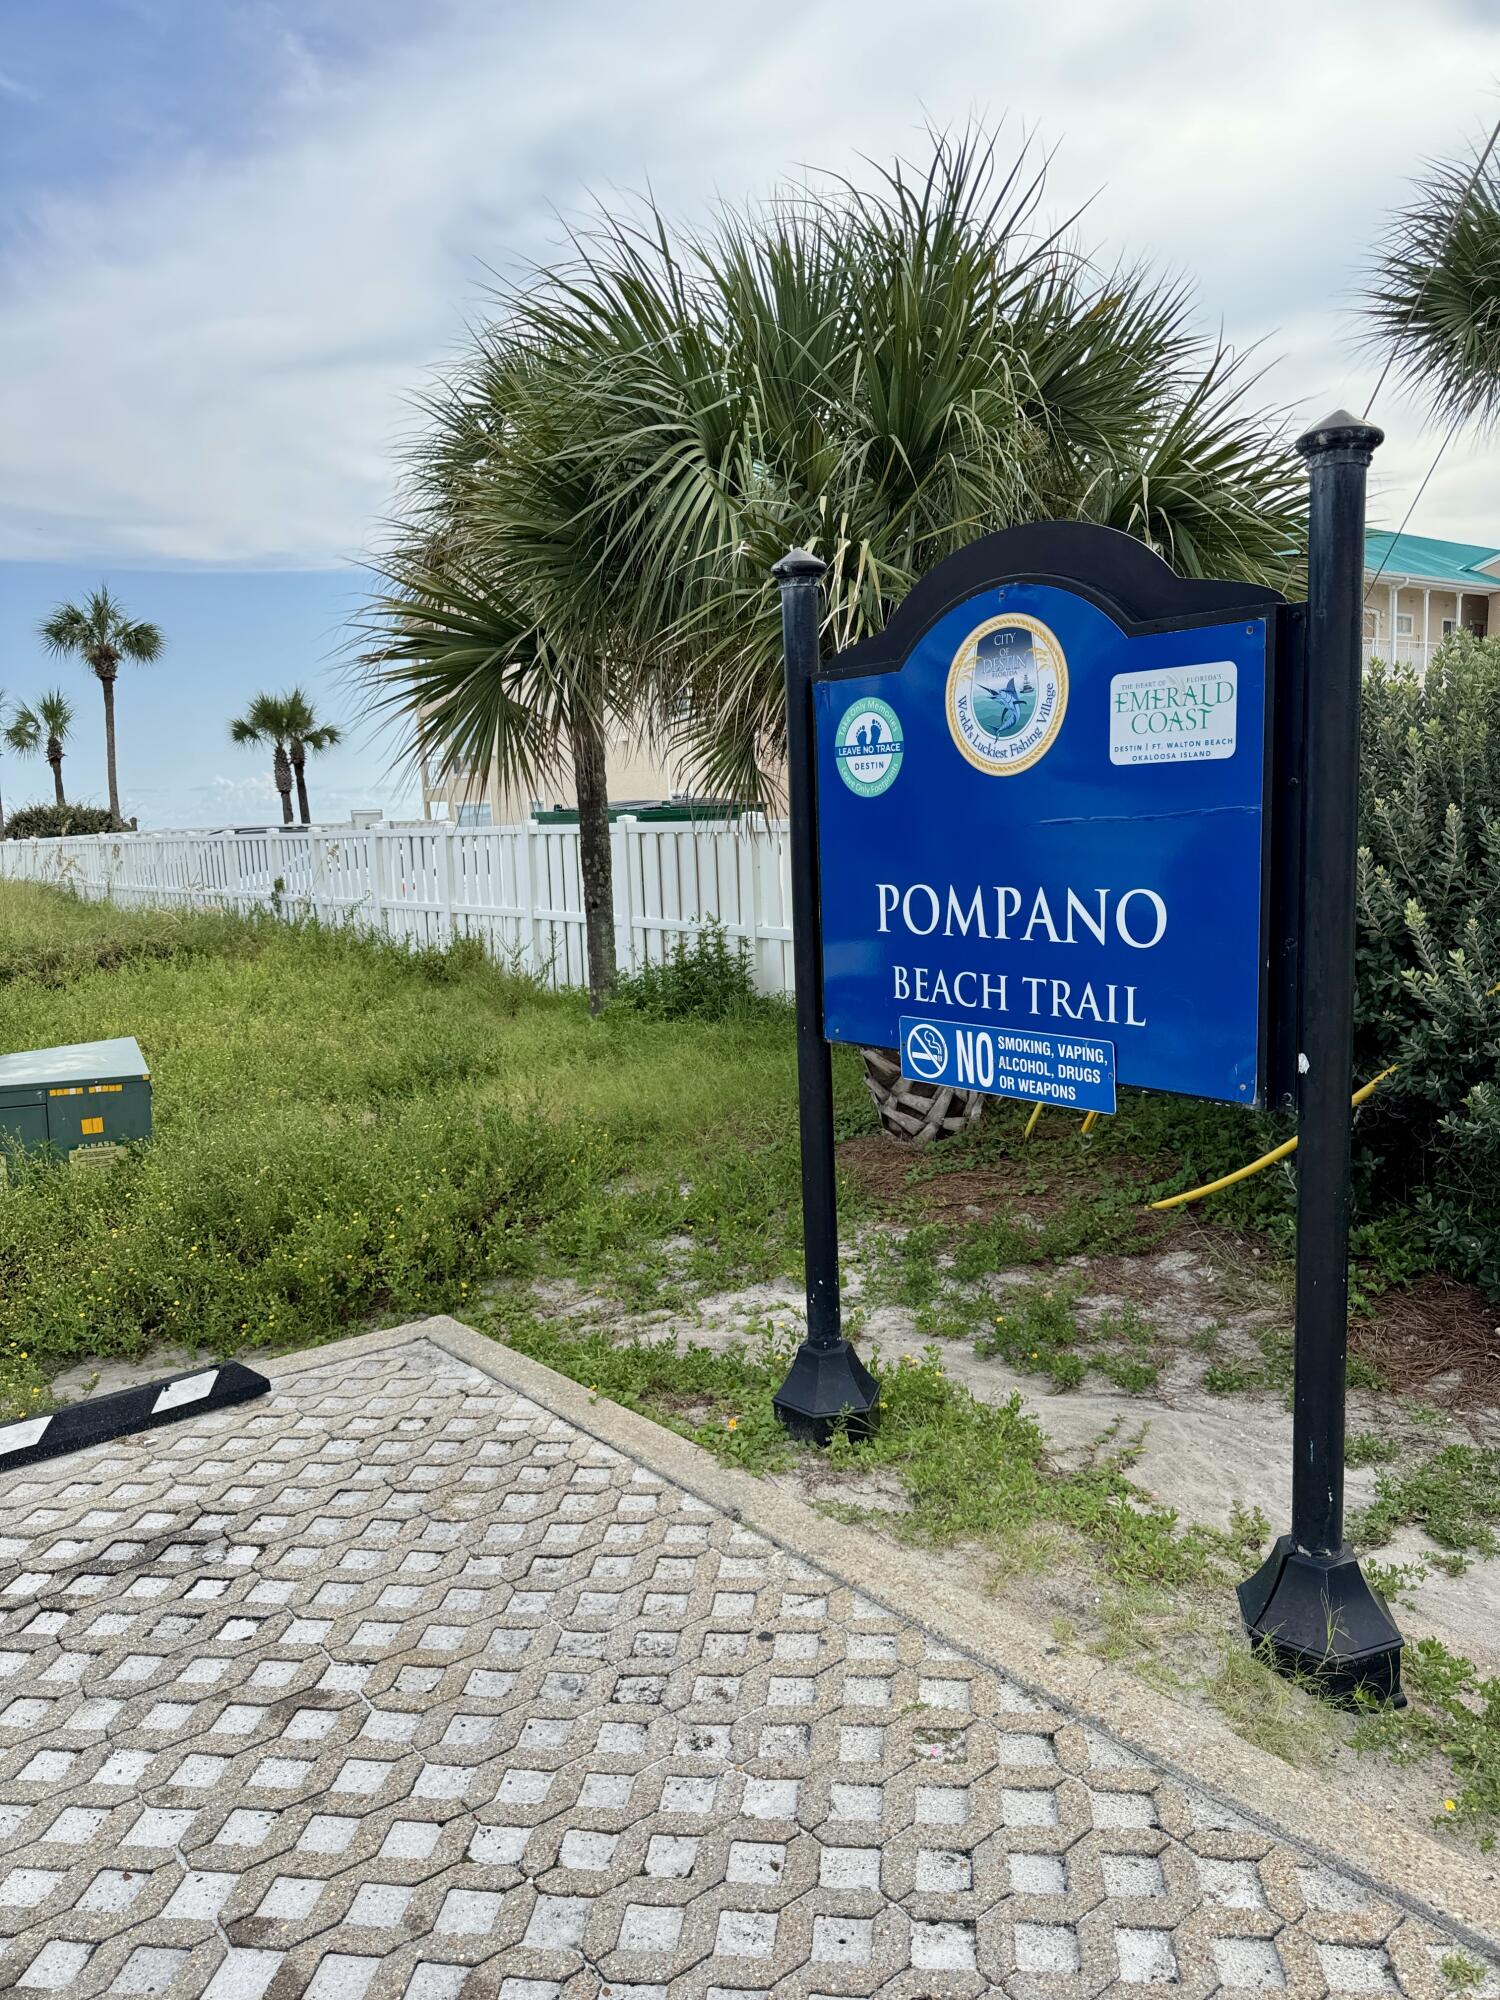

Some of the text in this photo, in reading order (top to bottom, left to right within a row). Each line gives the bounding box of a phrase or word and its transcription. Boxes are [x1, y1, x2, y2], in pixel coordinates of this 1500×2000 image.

[994, 632, 1016, 646] CITY
[1000, 647, 1010, 656] OF
[982, 654, 1027, 674] DESTIN
[992, 670, 1018, 678] FLORIDA
[1136, 681, 1156, 690] HEART
[1186, 674, 1222, 683] FLORIDA'S
[1115, 681, 1234, 713] EMERALD
[850, 702, 866, 716] Only
[867, 700, 898, 733] Memories
[957, 682, 1056, 759] World's Luckiest Fishing Village
[1131, 708, 1213, 734] COAST
[839, 743, 900, 756] LEAVE NO TRACE
[1114, 743, 1142, 752] DESTIN
[1166, 740, 1201, 749] WALTON
[1204, 738, 1233, 746] BEACH
[1132, 750, 1212, 762] OKALOOSA ISLAND
[854, 762, 884, 770] DESTIN
[841, 763, 899, 795] Leave Only Footprints
[875, 884, 1168, 949] POMPANO
[892, 965, 1146, 1027] BEACH TRAIL
[956, 1030, 994, 1088] NO
[998, 1036, 1108, 1066] SMOKING, VAPING,
[998, 1056, 1100, 1084] ALCOHOL, DRUGS
[999, 1075, 1076, 1100] OR WEAPONS
